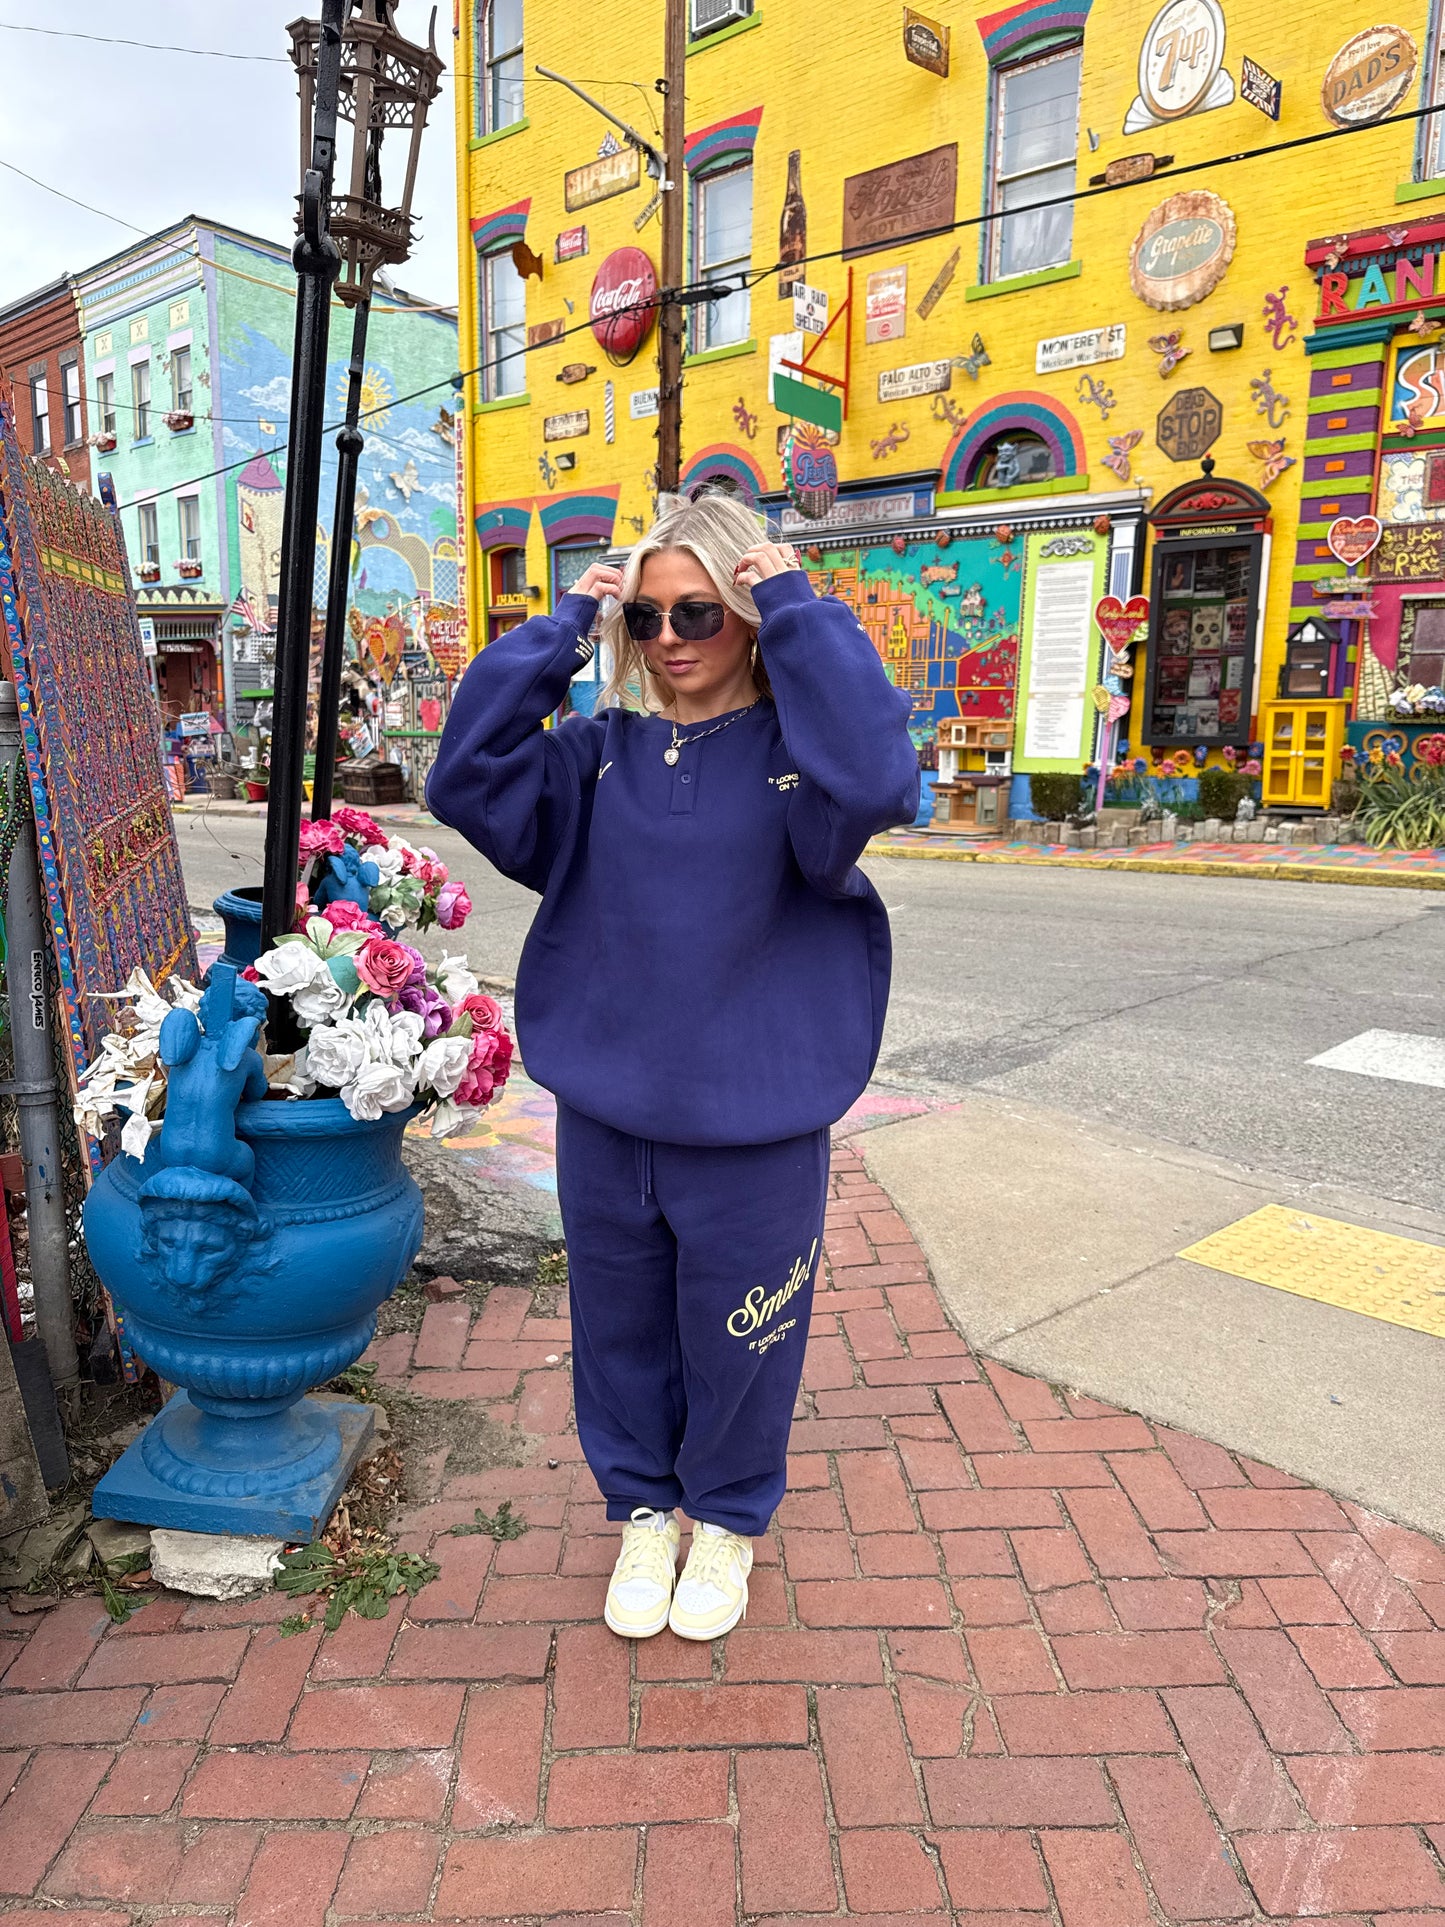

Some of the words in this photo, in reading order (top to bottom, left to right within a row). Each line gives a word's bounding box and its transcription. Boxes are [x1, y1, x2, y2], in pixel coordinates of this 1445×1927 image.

[1332, 43, 1401, 106] DAD'S
[793, 283, 806, 300] AIR
[811, 289, 828, 307] RAID
[1321, 253, 1445, 316] RAN
[795, 313, 826, 335] SHELTER
[881, 369, 905, 385] PALO
[908, 365, 930, 381] ALTO
[1175, 393, 1205, 411] DEAD
[1160, 409, 1217, 442] STOP
[1175, 442, 1199, 456] END
[456, 418, 465, 557] INTERNATIONAL
[883, 496, 912, 513] CITY
[1179, 525, 1237, 537] INFORMATION
[458, 565, 468, 638] WELCOME
[776, 773, 799, 785] LOOKS
[779, 782, 790, 791] ON
[33, 951, 43, 992] ENRICO
[31, 993, 45, 1029] JAMES
[749, 1340, 758, 1350] IT
[778, 1318, 797, 1333] GOOD
